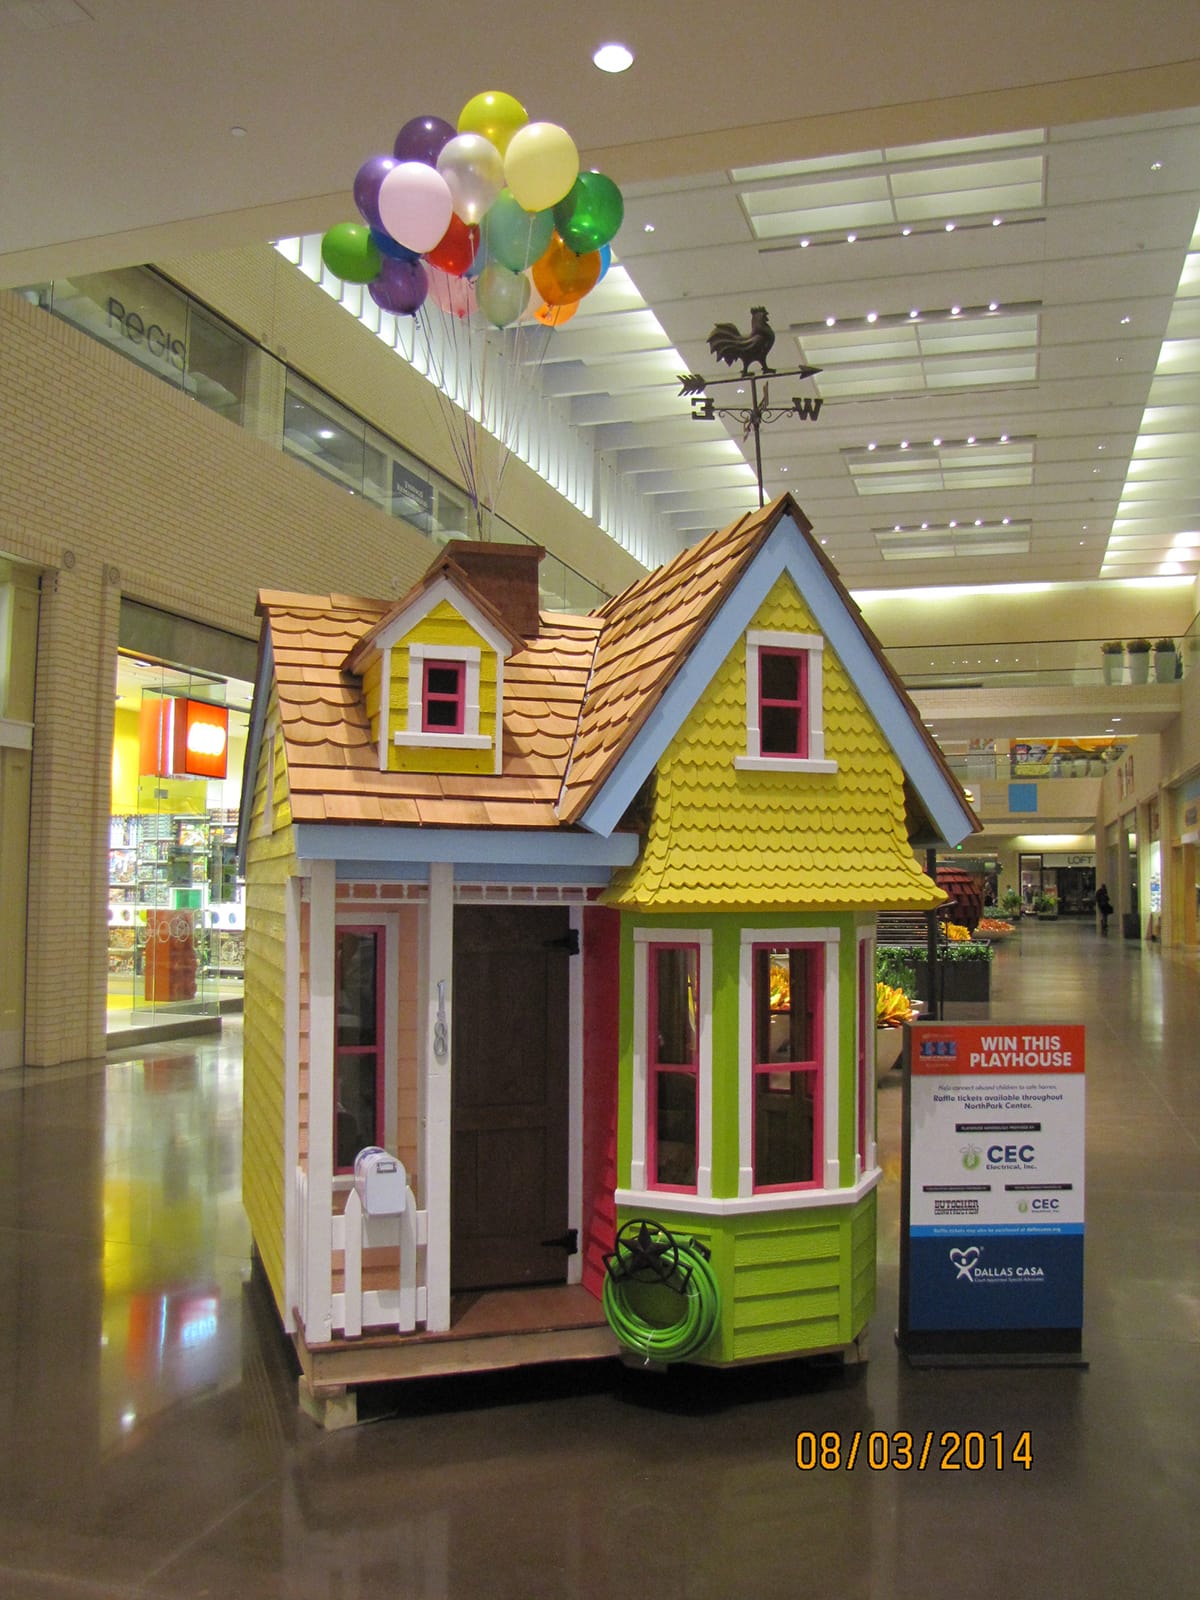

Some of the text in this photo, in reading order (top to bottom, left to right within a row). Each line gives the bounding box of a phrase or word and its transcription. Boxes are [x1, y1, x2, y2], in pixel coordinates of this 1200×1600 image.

[792, 398, 823, 420] W
[1067, 856, 1094, 865] LOFT
[980, 1036, 1061, 1051] WIN THIS
[970, 1052, 1072, 1068] PLAYHOUSE
[933, 1094, 956, 1102] Raffle
[957, 1094, 982, 1102] tickets
[1022, 1093, 1063, 1102] throughout
[986, 1145, 1035, 1163] CEC
[1032, 1199, 1060, 1209] CEC
[975, 1266, 1044, 1277] DALLAS CASA
